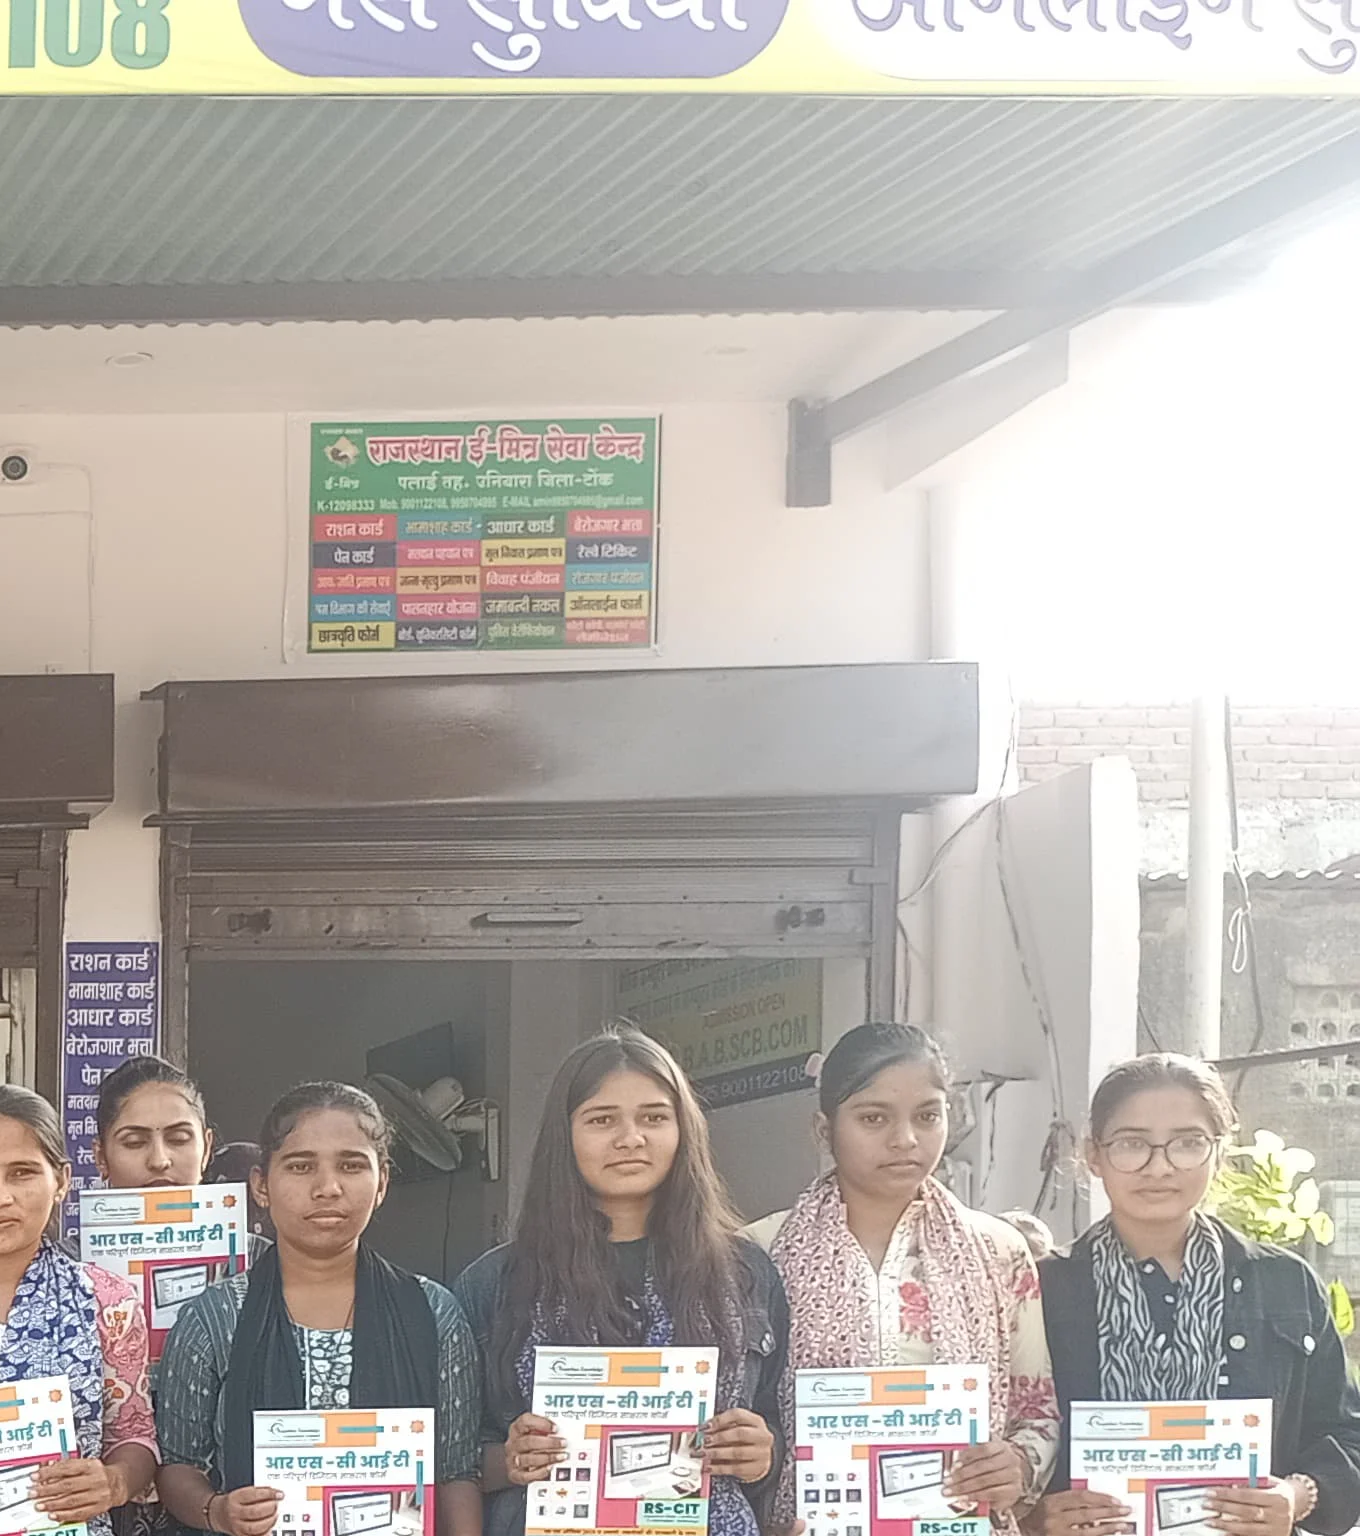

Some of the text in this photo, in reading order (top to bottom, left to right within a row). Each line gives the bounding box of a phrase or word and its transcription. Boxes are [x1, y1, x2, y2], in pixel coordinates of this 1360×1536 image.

[366, 435, 464, 465] राजस्थान
[466, 425, 540, 467] ई-मित्र
[544, 425, 590, 463] सेवा
[528, 515, 555, 533] कार्ड
[68, 947, 150, 972] राशन कार्ड
[126, 976, 156, 1000] कार्ड
[67, 1003, 154, 1027] आधार कार्ड
[66, 1033, 125, 1056] बेरोजगार
[90, 1234, 115, 1247] आर
[119, 1232, 143, 1245] एस
[155, 1227, 174, 1243] सी
[177, 1225, 206, 1242] आई
[208, 1224, 223, 1240] टी
[545, 1395, 575, 1409] आर
[578, 1395, 604, 1408] एस
[617, 1391, 639, 1408] सी
[642, 1392, 674, 1409] आई
[676, 1391, 692, 1408] टी
[808, 1415, 838, 1428] आर
[842, 1414, 868, 1427] एस
[883, 1410, 904, 1427] सी
[909, 1410, 943, 1427] आई
[944, 1409, 962, 1425] टी
[8, 1423, 36, 1441] आई
[37, 1420, 52, 1438] टी
[266, 1456, 293, 1469] आर
[297, 1455, 322, 1469] एस
[336, 1452, 355, 1469] सी
[360, 1451, 392, 1469] आई
[393, 1450, 409, 1467] टी
[1083, 1449, 1114, 1462] आर
[1118, 1448, 1146, 1461] एस
[1160, 1444, 1182, 1461] सी
[1187, 1444, 1223, 1461] आई
[1224, 1443, 1242, 1460] टी
[644, 1503, 700, 1515] RS-CIT
[920, 1522, 978, 1534] RS-CIT
